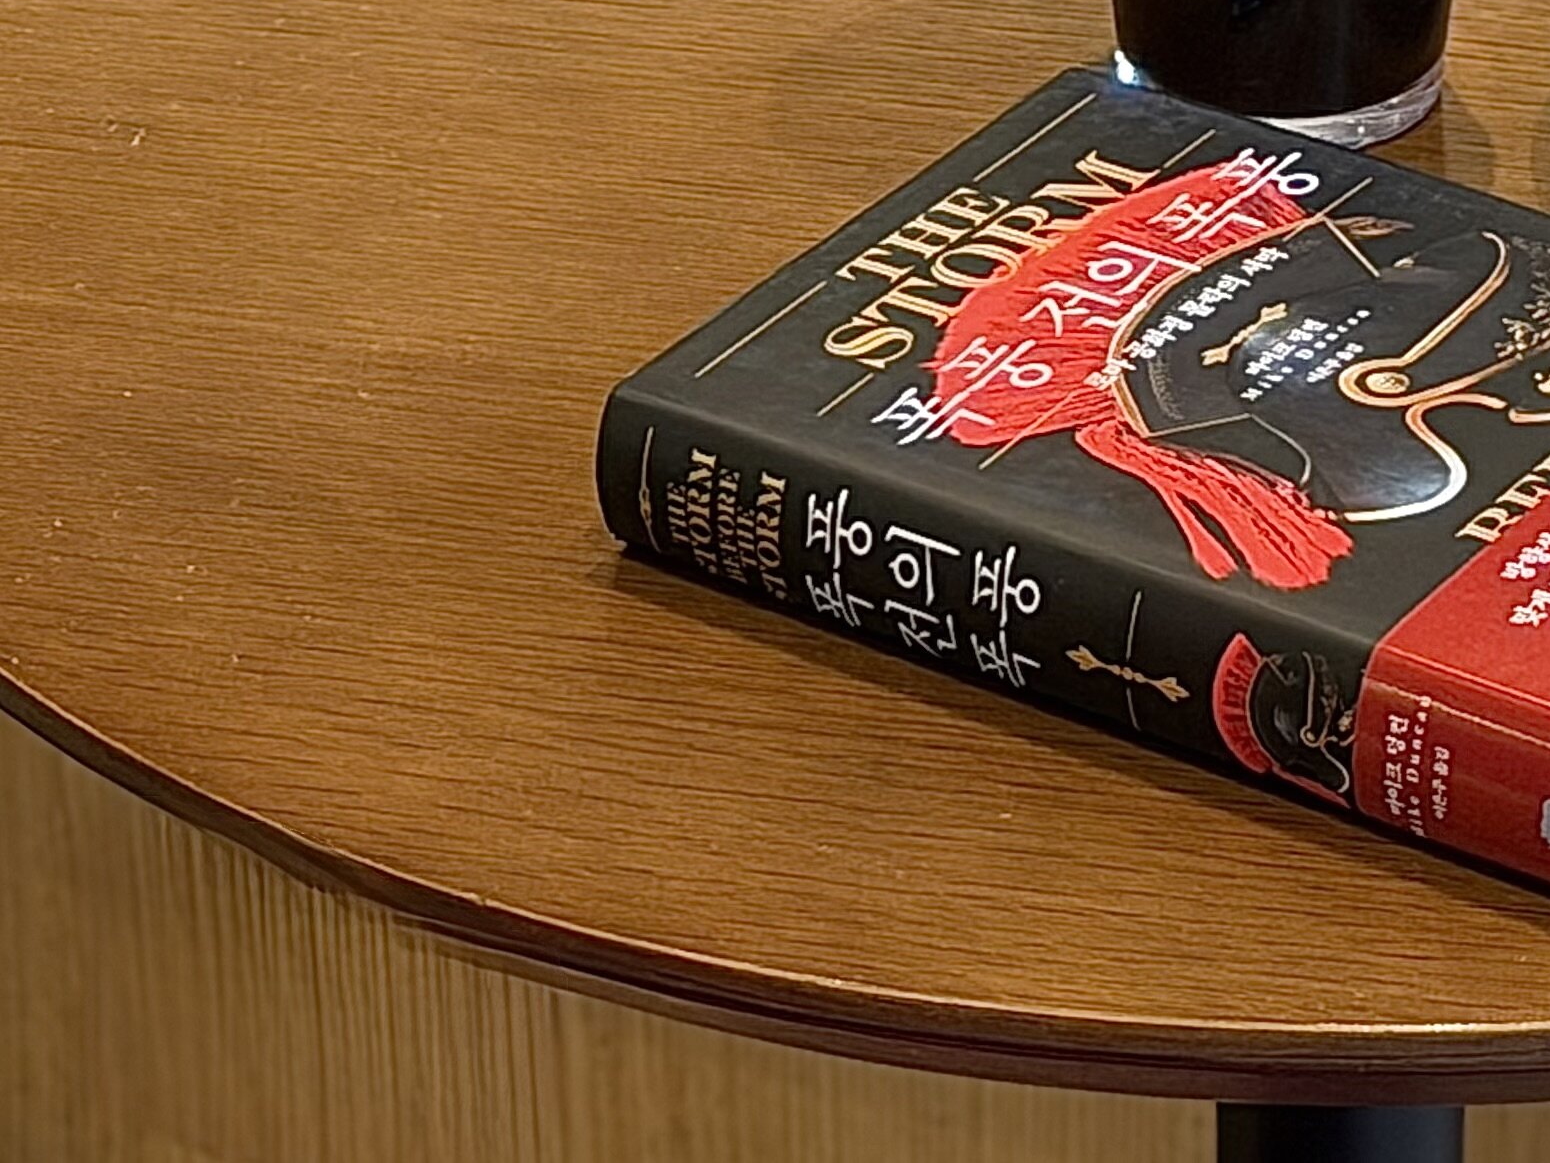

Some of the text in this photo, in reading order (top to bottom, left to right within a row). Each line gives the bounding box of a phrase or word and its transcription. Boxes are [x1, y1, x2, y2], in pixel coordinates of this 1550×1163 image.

[824, 150, 1161, 369] STORM
[835, 188, 1010, 283] THE
[871, 148, 1319, 446] 폭풍 전의 폭풍
[1083, 246, 1290, 391] 로마 공화정 몰락의 서막
[1245, 340, 1298, 376] 마이크
[667, 482, 691, 544] THE
[736, 506, 758, 567] THE
[805, 488, 875, 627] 폭풍
[884, 525, 961, 659] 전의
[970, 546, 1041, 687] 폭풍
[1383, 762, 1406, 815] 마이크
